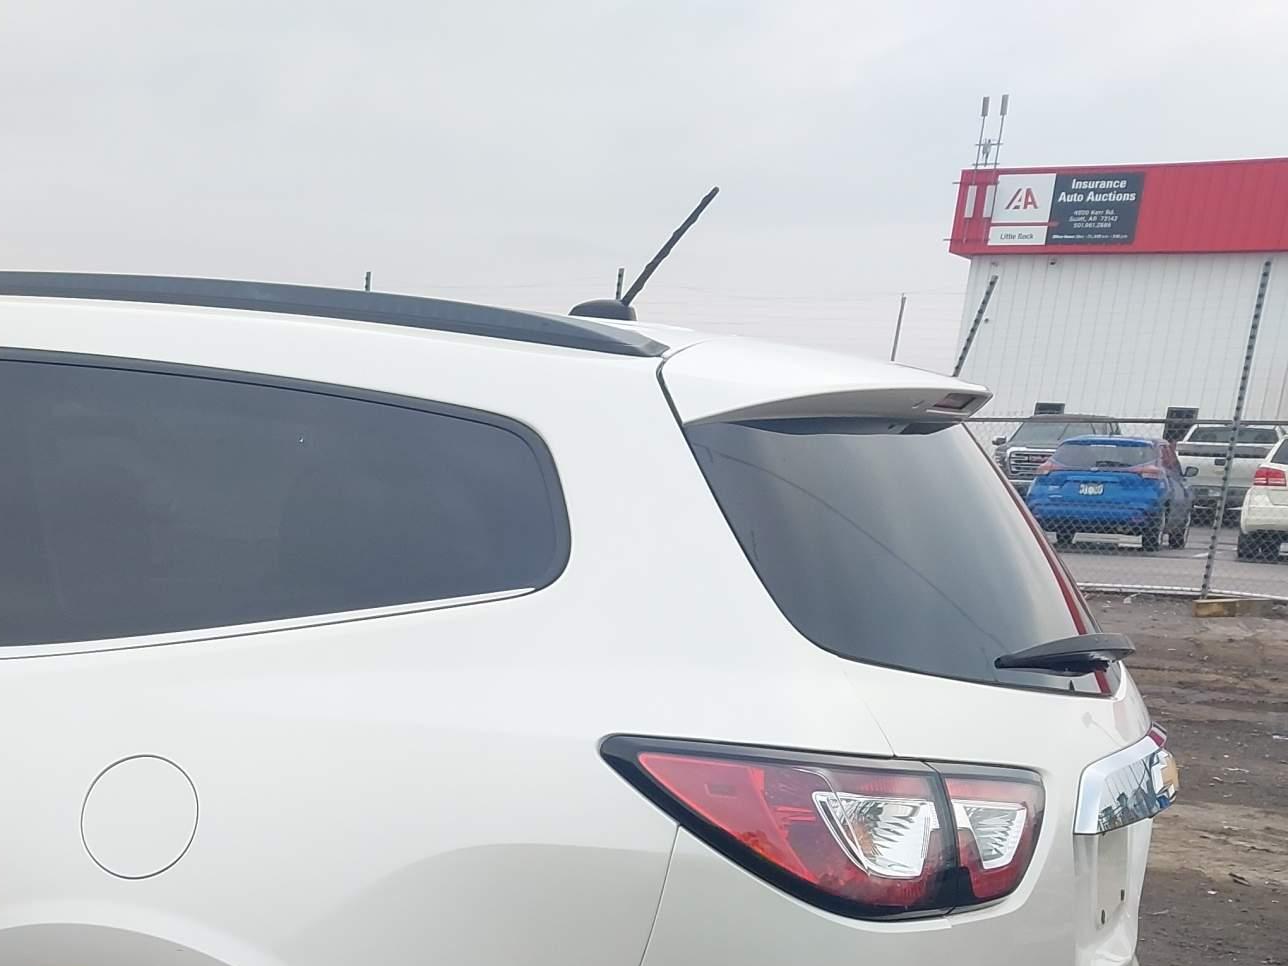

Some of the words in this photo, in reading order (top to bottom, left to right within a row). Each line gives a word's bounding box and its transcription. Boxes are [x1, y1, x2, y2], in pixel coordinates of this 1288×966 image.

[1071, 178, 1127, 189] Insurance
[1058, 191, 1084, 203] Auto
[1086, 190, 1136, 202] Auctions
[1000, 232, 1016, 240] Little
[1017, 231, 1034, 239] Rock
